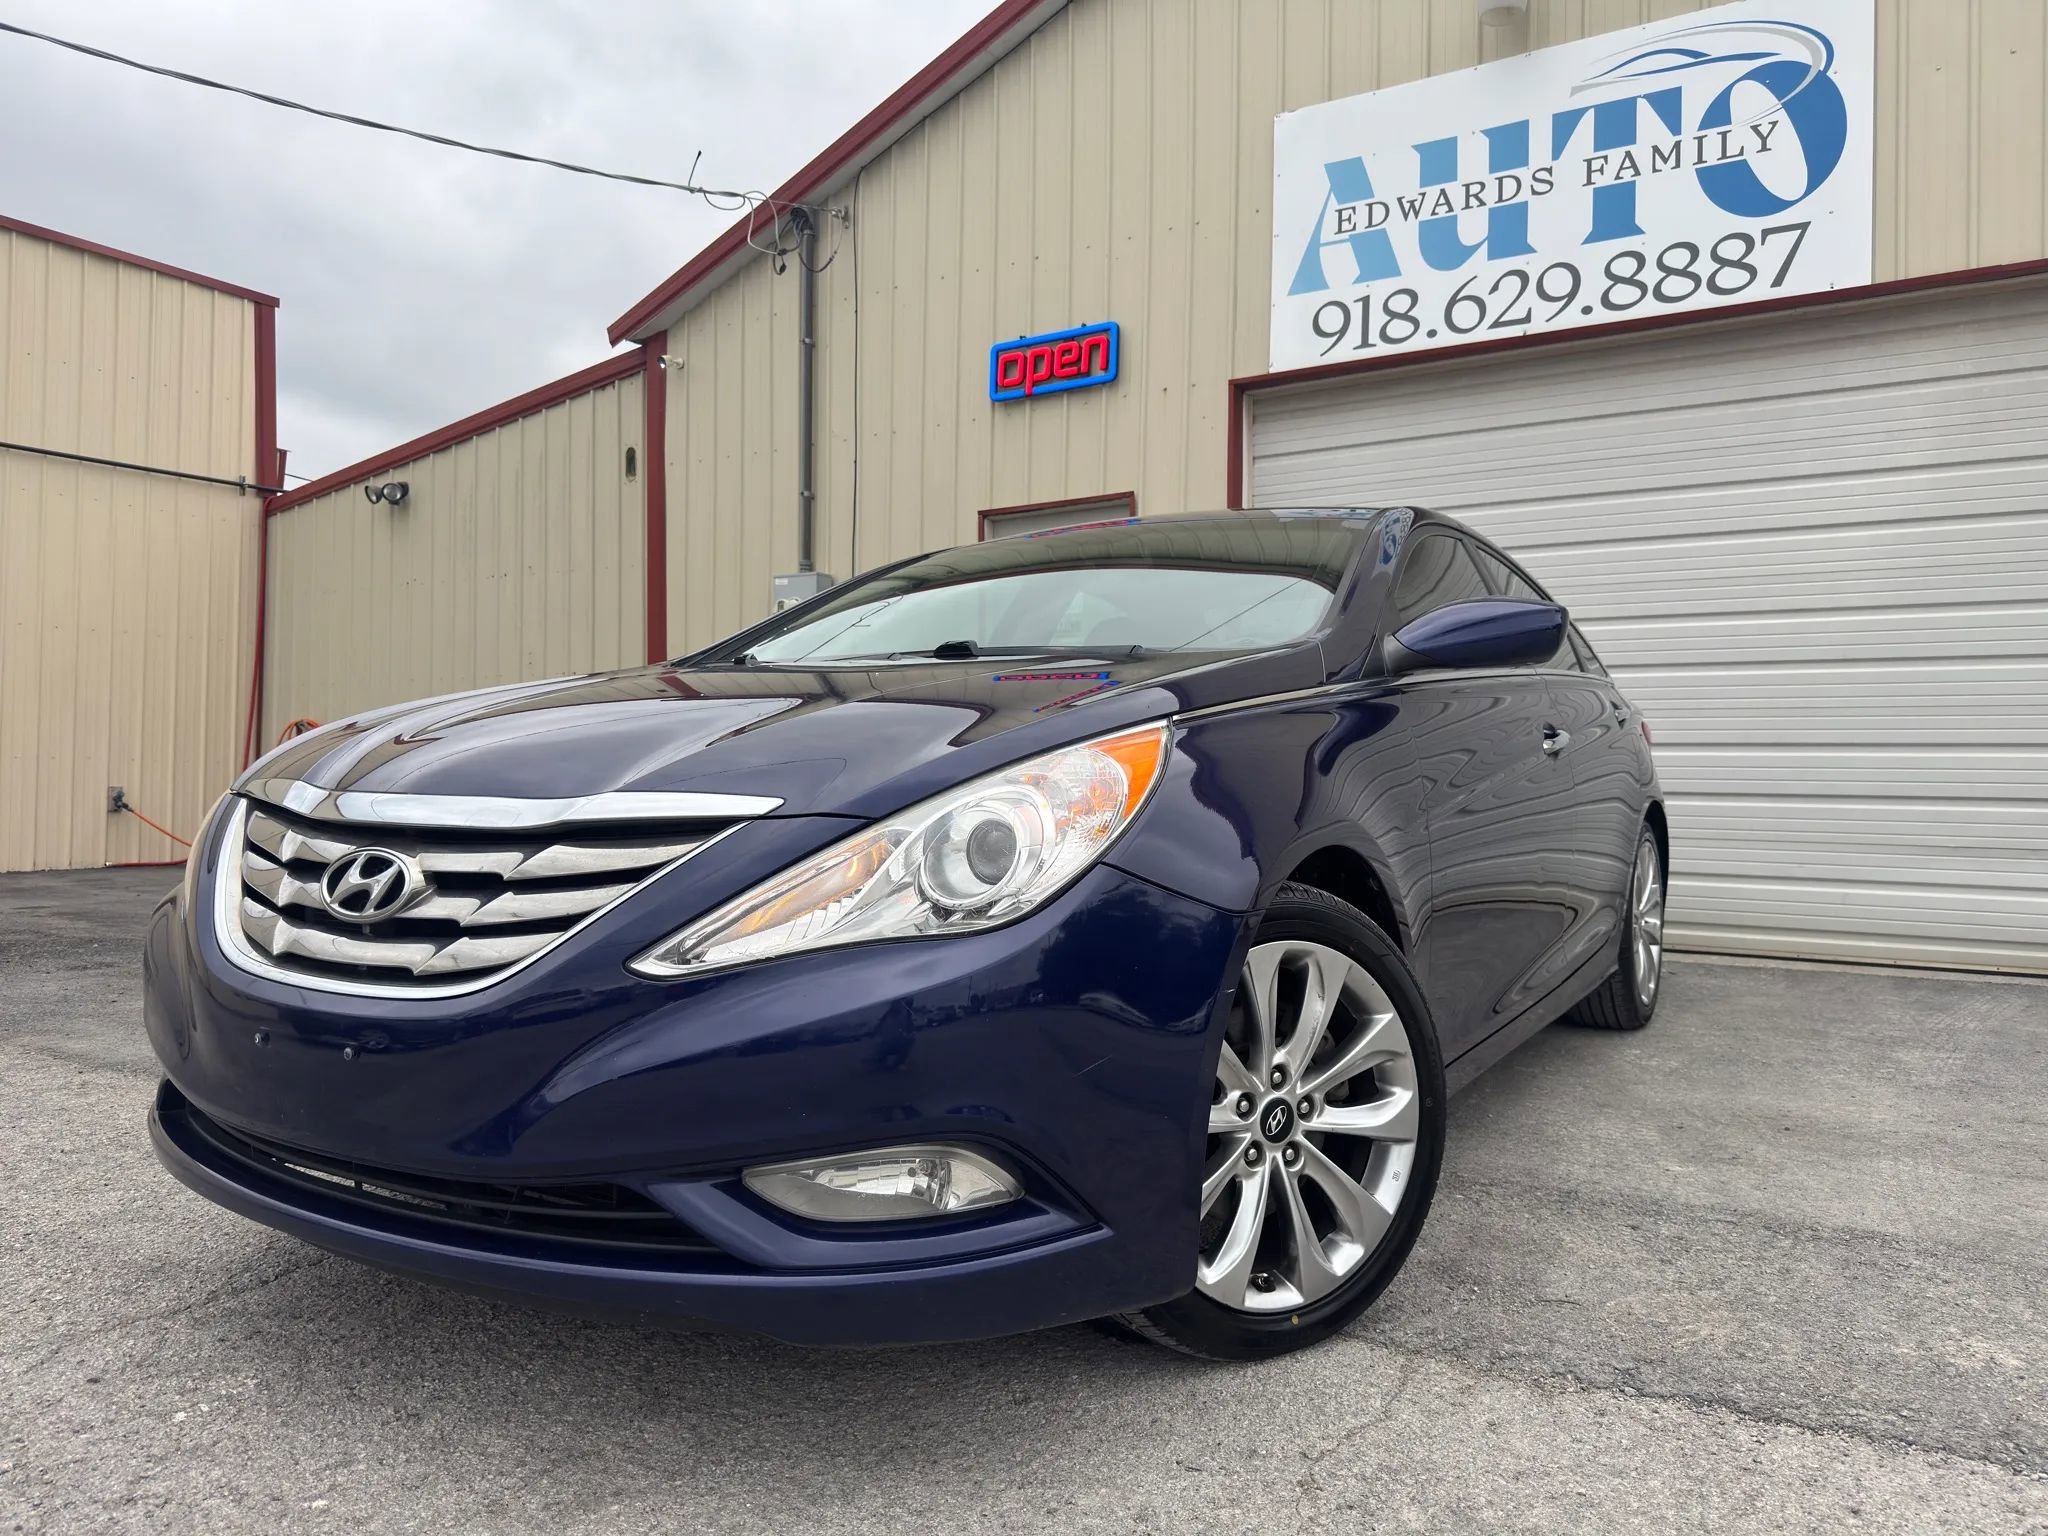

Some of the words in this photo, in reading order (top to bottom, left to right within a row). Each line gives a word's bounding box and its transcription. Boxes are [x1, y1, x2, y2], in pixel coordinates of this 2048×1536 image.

[1287, 60, 1848, 296] AUTO
[1333, 166, 1555, 236] EDWARDS
[1581, 119, 1780, 189] FAMILY
[1311, 221, 1812, 358] 918.629.8887
[997, 335, 1109, 397] open
